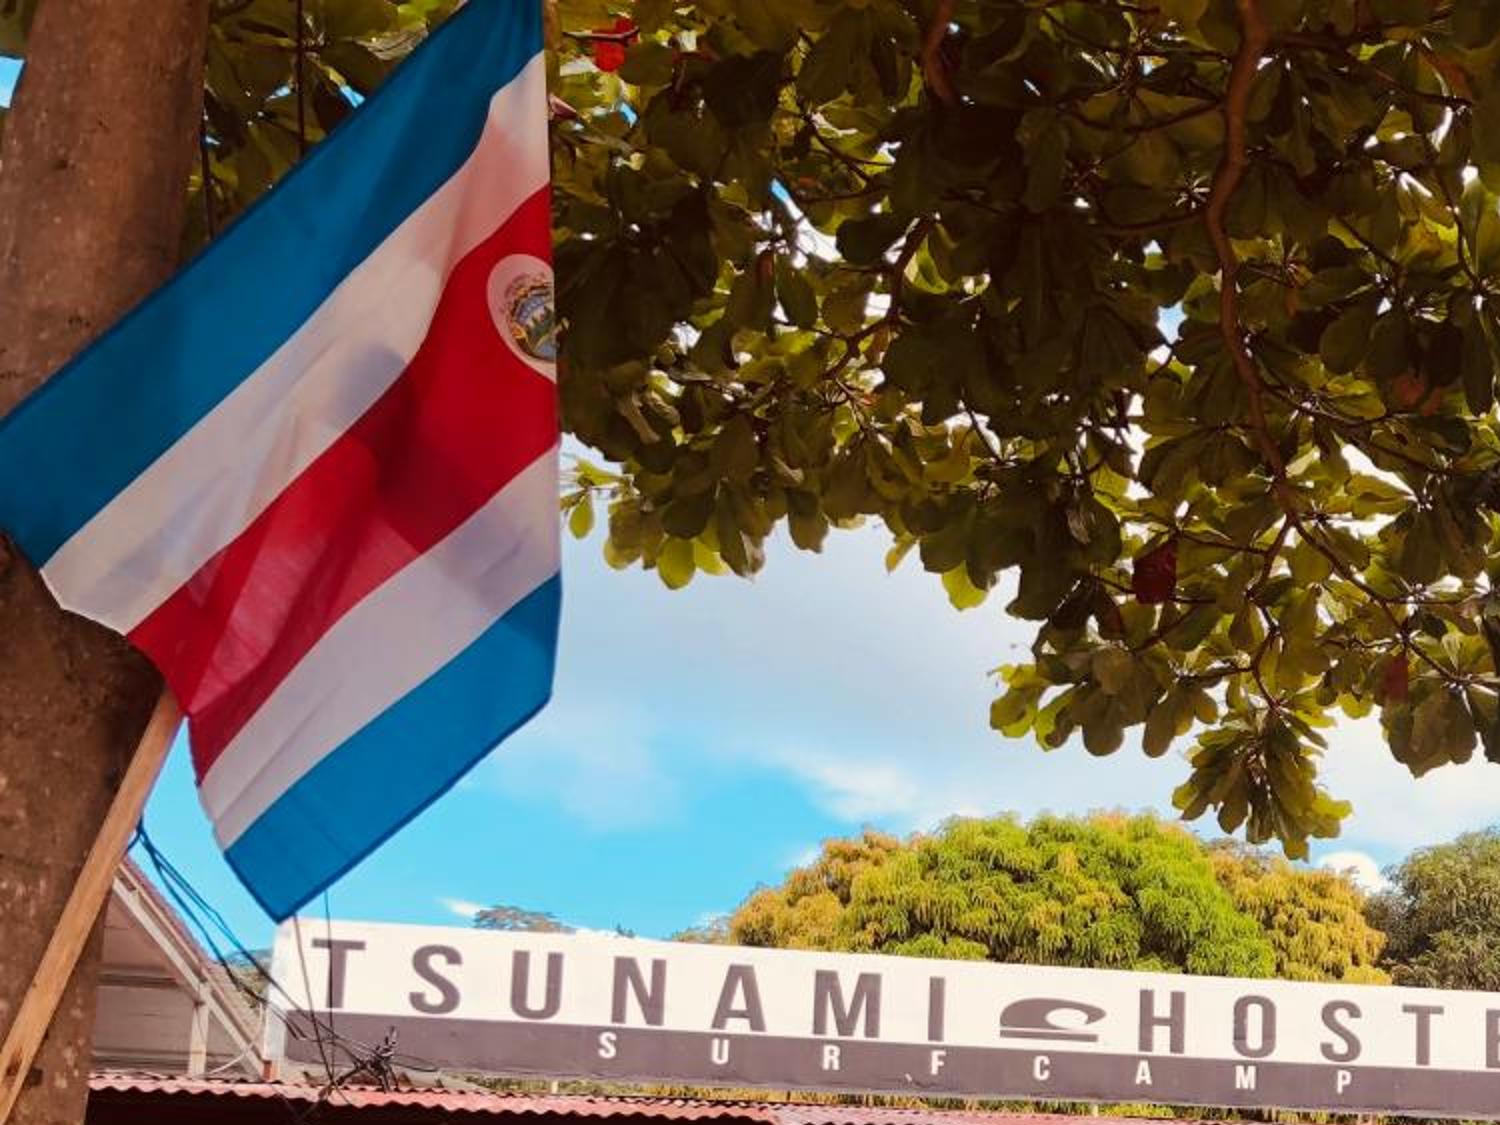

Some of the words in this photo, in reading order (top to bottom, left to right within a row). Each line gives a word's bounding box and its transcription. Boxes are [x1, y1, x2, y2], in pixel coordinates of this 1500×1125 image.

[311, 937, 946, 1042] TSUNAMI
[598, 1031, 948, 1077] SURF
[1032, 1054, 1352, 1095] CAMP
